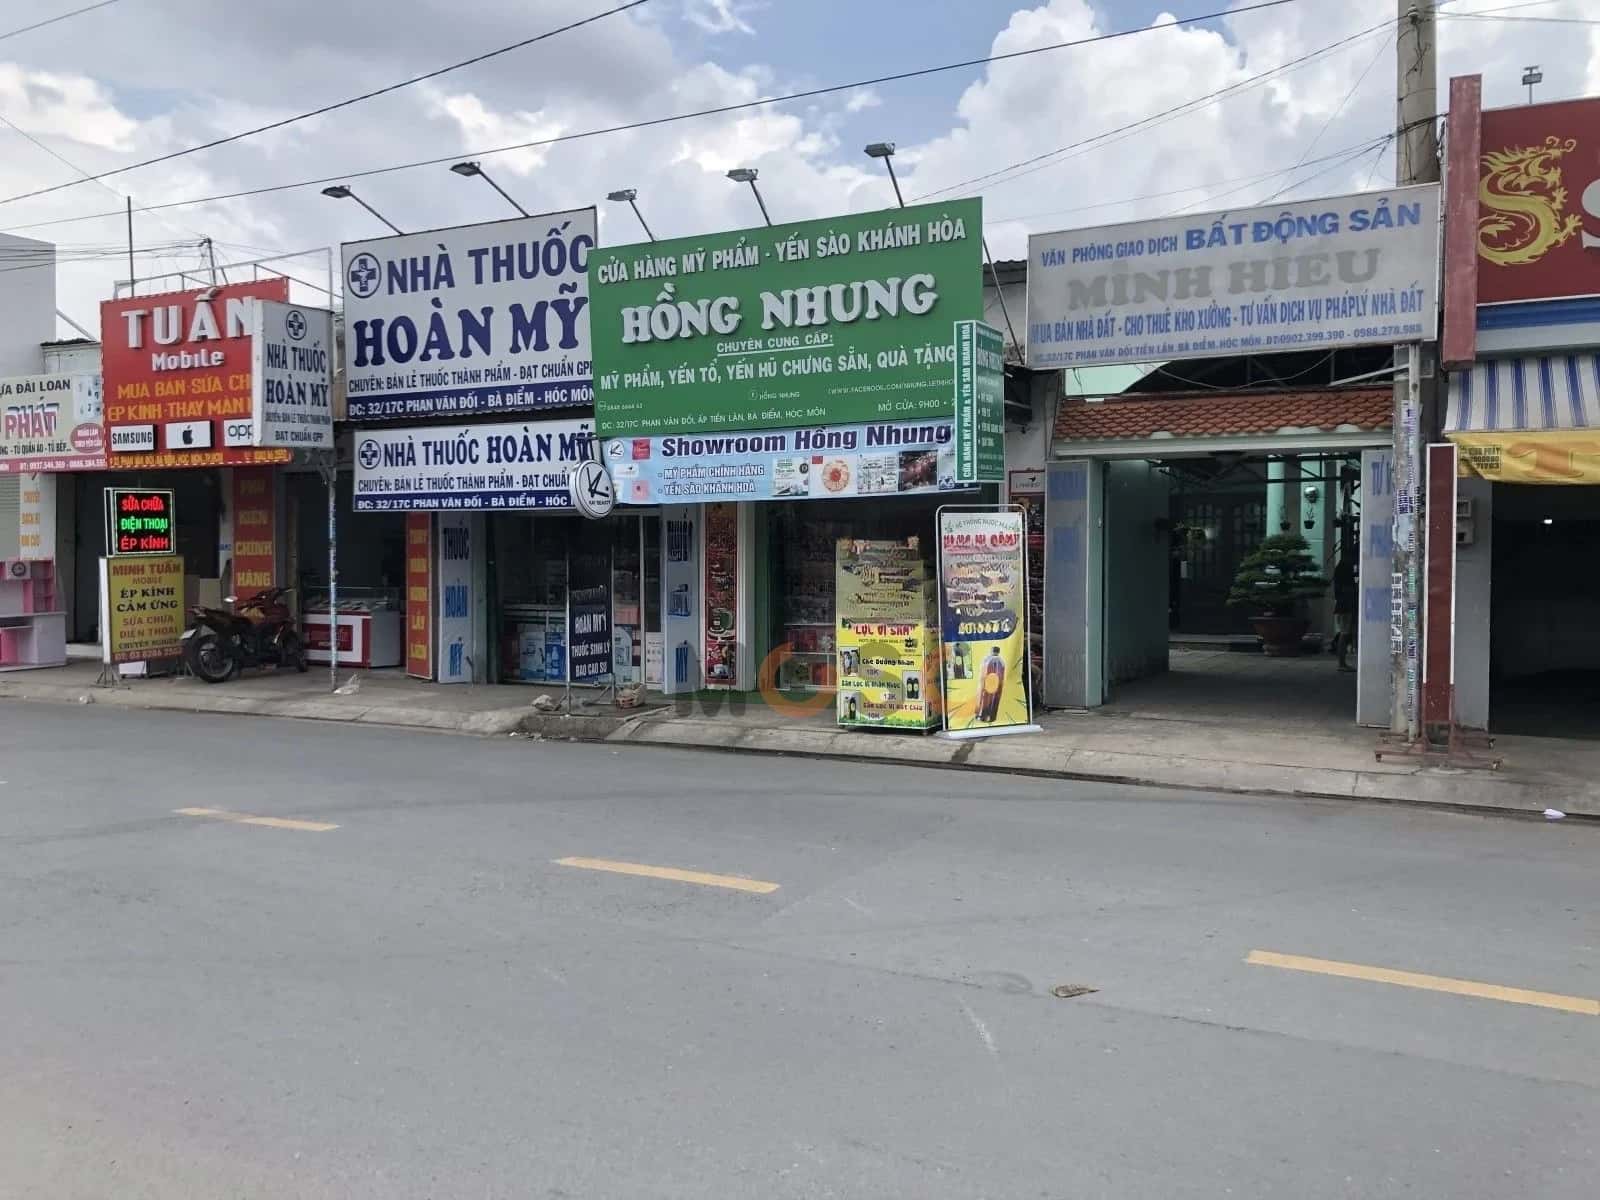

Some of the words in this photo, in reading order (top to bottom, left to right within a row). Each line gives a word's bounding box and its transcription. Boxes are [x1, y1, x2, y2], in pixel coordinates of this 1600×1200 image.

[1042, 248, 1066, 267] VĂN
[1072, 242, 1114, 264] PHÒNG
[1115, 240, 1145, 258] GIAO
[1148, 235, 1178, 256] DỊCH
[1185, 213, 1248, 250] BẤT
[1252, 210, 1340, 244] ĐỘNG
[1349, 197, 1421, 232] SẢN
[387, 244, 455, 295] NHÀ
[468, 221, 593, 285] THUỐC
[598, 256, 629, 285] CỬA
[633, 254, 677, 280] HÀNG
[682, 247, 706, 275] MỸ
[712, 236, 760, 271] PHẨM
[774, 231, 810, 263] YẾN
[816, 229, 851, 260] SÀO
[857, 221, 921, 253] KHÁNH
[927, 213, 967, 243] HÒA
[1067, 265, 1213, 312] MINH
[121, 287, 256, 348] TUẤN
[621, 282, 742, 345] HỒNG
[760, 273, 938, 331] NHUNG
[1031, 320, 1052, 345] MUA
[1054, 316, 1074, 342] BÁN
[1075, 314, 1095, 341] NHÀ
[1096, 309, 1116, 339] ĐẤT
[1124, 314, 1144, 337] CHO
[1146, 306, 1172, 335] THUÊ
[1174, 308, 1195, 332] KHO
[1198, 299, 1231, 330] XƯỞNG
[1240, 302, 1255, 327] TƯ
[1256, 294, 1277, 325] VẤN
[1280, 300, 1305, 326] DỊCH
[1308, 298, 1322, 324] VỤ
[1371, 287, 1396, 316] NHÀ
[1400, 279, 1424, 312] ĐẤT
[353, 297, 494, 367] HOÀN
[509, 282, 588, 354] MỸ
[716, 337, 762, 353] CHUYÊN
[767, 336, 799, 348] CUNG
[805, 329, 833, 345] CẤP:
[151, 349, 225, 371] Mobile
[266, 339, 289, 370] NHÀ
[291, 340, 327, 374] THUỐC
[600, 370, 619, 391] MỸ
[624, 363, 664, 389] PHẨM,
[668, 362, 695, 384] YẾN
[699, 356, 721, 383] TỔ,
[726, 358, 754, 380] YẾN
[759, 356, 777, 377] HŨ
[782, 355, 833, 377] CHƯNG
[838, 345, 872, 373] SẴN,
[877, 345, 909, 370] QUÀ
[914, 342, 954, 370] TẶNG
[1075, 349, 1097, 360] PHAN
[349, 375, 385, 393] CHUYÊN:
[387, 375, 405, 390] BÁN
[407, 373, 417, 388] LẺ
[420, 368, 450, 387] THUỐC
[452, 367, 481, 386] THÀNH
[484, 360, 511, 383] PHẨM
[520, 363, 538, 382] ĐẠT
[541, 355, 574, 377] CHUẨN
[15, 380, 36, 394] ĐÀI
[39, 379, 71, 392] LOAN
[118, 382, 150, 400] MUA
[265, 373, 307, 406] HOÀN
[310, 378, 329, 407] MỸ
[168, 400, 205, 418] THAY
[207, 395, 244, 415] MÀN
[368, 400, 406, 415] 32/17C
[406, 398, 434, 413] PHAN
[436, 394, 457, 410] VĂN
[459, 390, 478, 408] ĐỐI
[488, 389, 505, 407] BÀ
[507, 386, 534, 406] ĐIỂM
[545, 388, 568, 403] HÓC
[571, 385, 594, 402] MÔN
[918, 399, 940, 409] 9H00
[4, 396, 60, 440] PHÁT
[642, 417, 661, 428] PHAN
[806, 405, 826, 417] MÔN
[961, 406, 972, 427] PHẨM
[112, 431, 153, 444] SAMSUNG
[384, 435, 416, 467] NHÀ
[422, 429, 480, 466] THUỐC
[487, 426, 553, 464] HOÀN
[661, 434, 786, 457] Showroom
[794, 425, 857, 450] Hồng
[866, 424, 952, 447] Nhung
[358, 479, 393, 492] CHUYÊN:
[394, 477, 411, 491] BÁN
[427, 472, 455, 490] THUỐC
[457, 474, 486, 489] THÀNH
[488, 468, 514, 488] PHẨM
[521, 472, 539, 489] ĐẠT
[663, 464, 679, 480] MỸ
[679, 463, 707, 479] PHẨM
[708, 462, 738, 478] CHÍNH
[663, 482, 682, 496] YẾN
[683, 482, 703, 495] SÀO
[703, 480, 733, 494] KHÁNH
[375, 498, 412, 509] 32/17C
[413, 498, 440, 508] PHAN
[442, 496, 463, 508] VĂN
[464, 495, 482, 507] ĐỐI
[491, 495, 506, 507] BÀ
[509, 493, 536, 507] ĐIỂM
[545, 496, 568, 506] HÓC
[120, 515, 142, 534] ĐIỆN
[143, 517, 168, 533] THOẠI
[120, 534, 137, 550] ÉP
[140, 534, 168, 549] KÍNH
[444, 520, 470, 561] THUỐC
[113, 563, 145, 577] MINH
[150, 559, 181, 575] TUẤN
[120, 588, 138, 599] ÉP
[141, 586, 175, 597] KÍNH
[445, 578, 468, 618] HOÀN
[116, 598, 147, 612] CẢM
[150, 598, 178, 611] ỨNG
